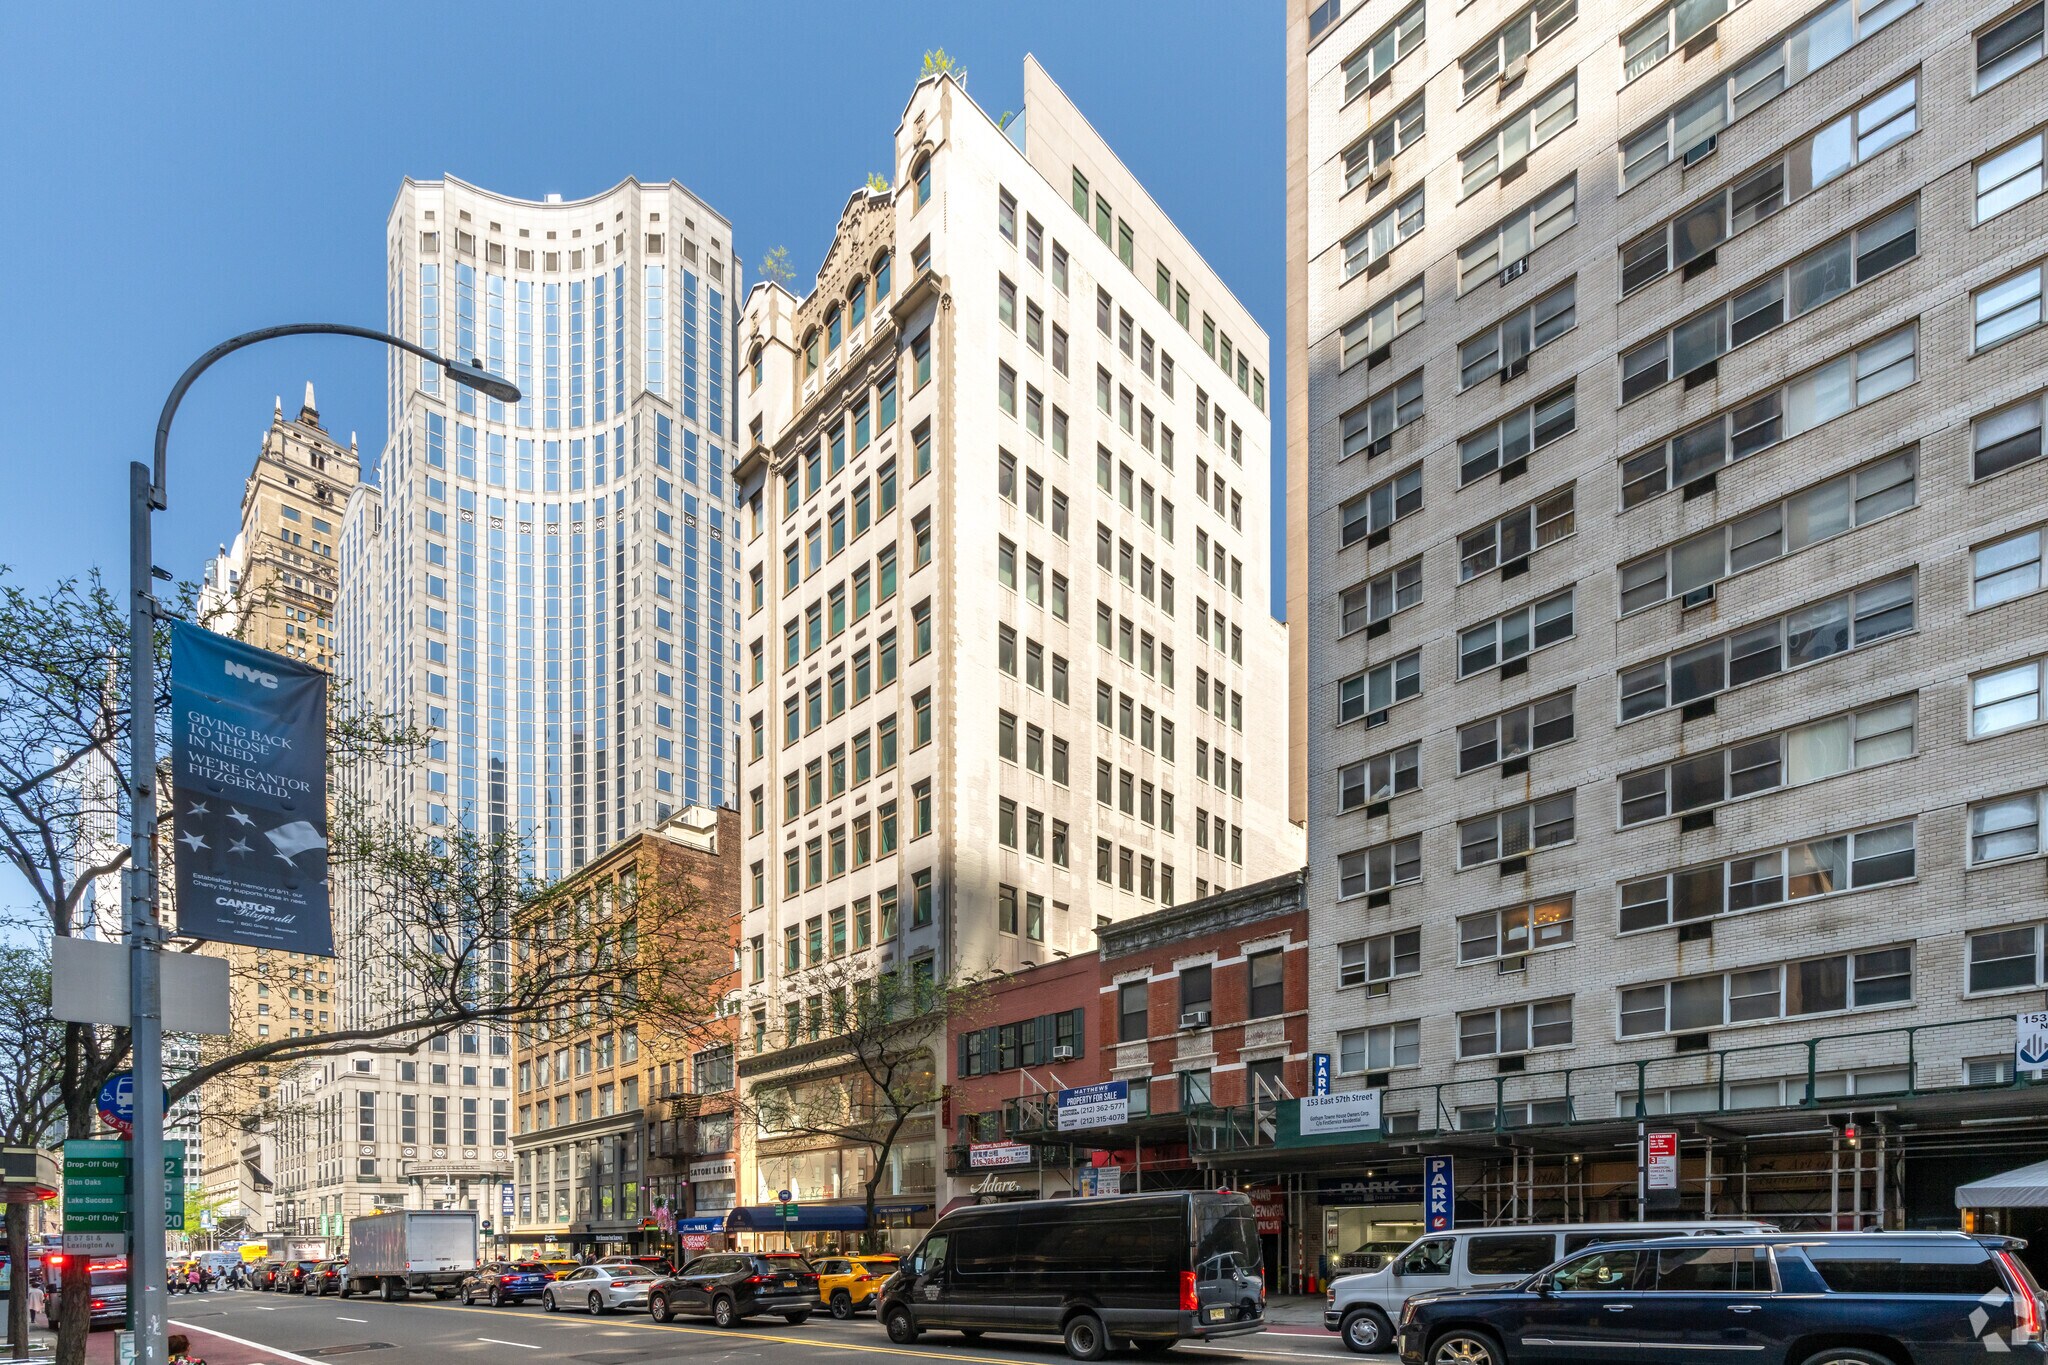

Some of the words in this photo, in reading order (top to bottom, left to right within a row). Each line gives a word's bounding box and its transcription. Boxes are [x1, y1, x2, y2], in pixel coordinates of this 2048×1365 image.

[225, 660, 278, 689] NYC
[188, 711, 246, 737] GIVING
[251, 730, 292, 750] BACK
[188, 721, 211, 738] TO
[215, 731, 270, 755] THOSE
[188, 734, 206, 748] IN
[211, 741, 257, 764] NEED.
[188, 750, 240, 775] WE'RE
[244, 768, 310, 793] CANTOR
[189, 763, 291, 799] FITZGERALD.
[193, 872, 231, 885] Established
[241, 883, 267, 892] memory
[193, 880, 217, 890] Charity
[218, 884, 232, 892] Day
[233, 888, 263, 898] supports
[264, 893, 282, 901] those
[215, 897, 275, 915] CANTOR
[234, 907, 296, 924] Fitzgerald
[2022, 1013, 2047, 1024] 153
[1317, 1056, 1327, 1097] PARK
[1066, 1095, 1093, 1106] PROPERTY
[1092, 1093, 1103, 1103] FOR
[1103, 1090, 1117, 1101] SALE
[1074, 1085, 1109, 1095] MATTHEWS
[1081, 1106, 1095, 1114] (212)
[1096, 1102, 1125, 1113] 362-5771
[1307, 1098, 1319, 1107] 153
[1320, 1097, 1334, 1105] East
[1335, 1095, 1351, 1104] 57th
[1351, 1093, 1373, 1102] Street
[104, 1113, 116, 1125] NO
[1081, 1116, 1095, 1125] (212)
[1096, 1113, 1125, 1123] 315-4078
[67, 1161, 100, 1169] Drop-Off
[102, 1161, 119, 1170] Only
[690, 1168, 712, 1177] SATORI
[713, 1165, 732, 1175] LASER
[970, 1172, 1017, 1194] Adare
[1341, 1180, 1400, 1194] PARK
[1431, 1160, 1448, 1213] PARK
[102, 1215, 119, 1223] Only
[165, 1215, 182, 1228] 20
